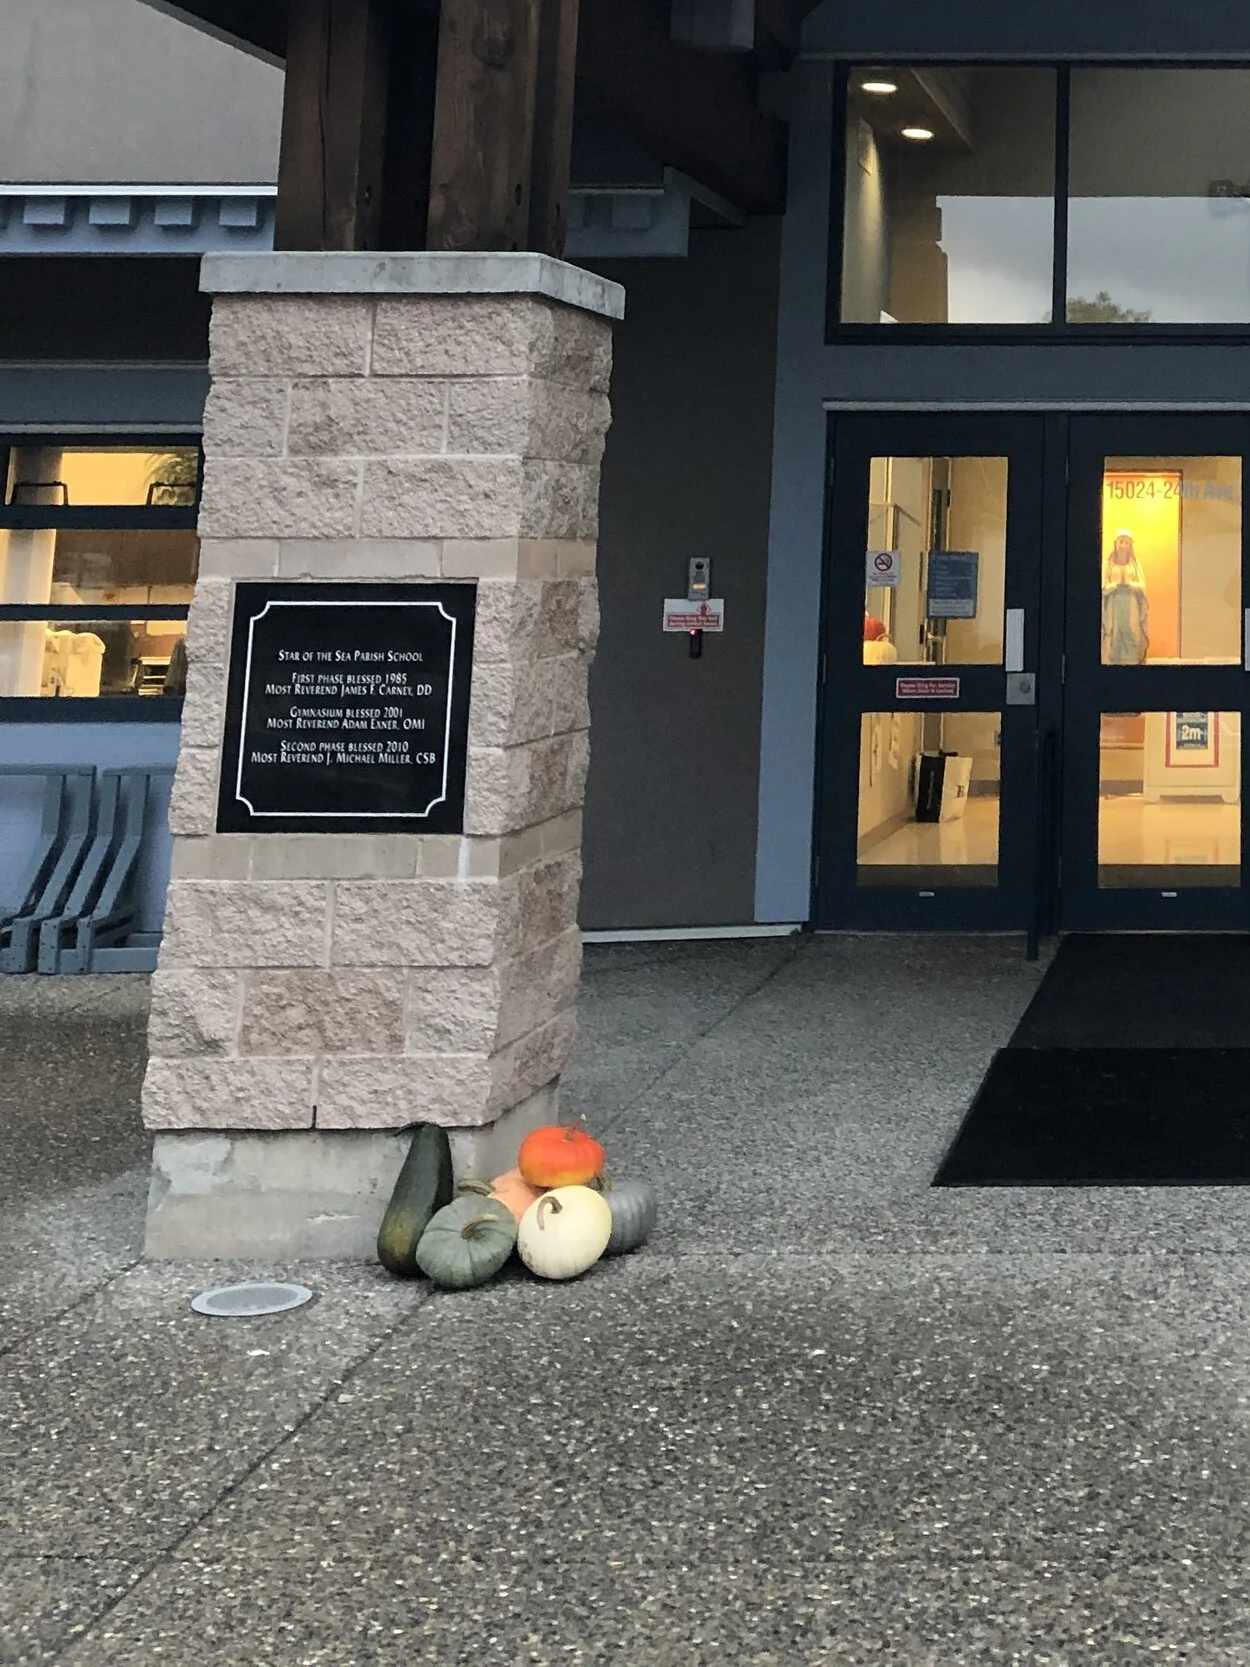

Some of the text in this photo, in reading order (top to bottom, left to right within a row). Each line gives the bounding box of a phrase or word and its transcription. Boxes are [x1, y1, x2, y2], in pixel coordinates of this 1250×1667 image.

[278, 649, 424, 662] STAR OF THE SEA PARISH SCHOOL
[292, 673, 407, 684] FIRST PHASE BLESSED 1985
[265, 684, 291, 694] MOST
[294, 684, 337, 695] REVEREND
[341, 684, 367, 697] JAMES
[417, 685, 432, 696] DD
[290, 706, 403, 718] GYMNASIUM BLESSED 2001
[267, 718, 293, 729] MOST
[296, 718, 339, 729] REVEREND
[342, 718, 368, 729] ADAM
[403, 718, 424, 730] OMI
[1181, 724, 1201, 740] 2m
[280, 740, 408, 752] SECOND PHASE BLESSED 2010
[251, 752, 277, 763] MOST
[280, 752, 324, 763] REVEREND
[336, 752, 375, 764] MICHAEL
[416, 752, 436, 764] CSB
